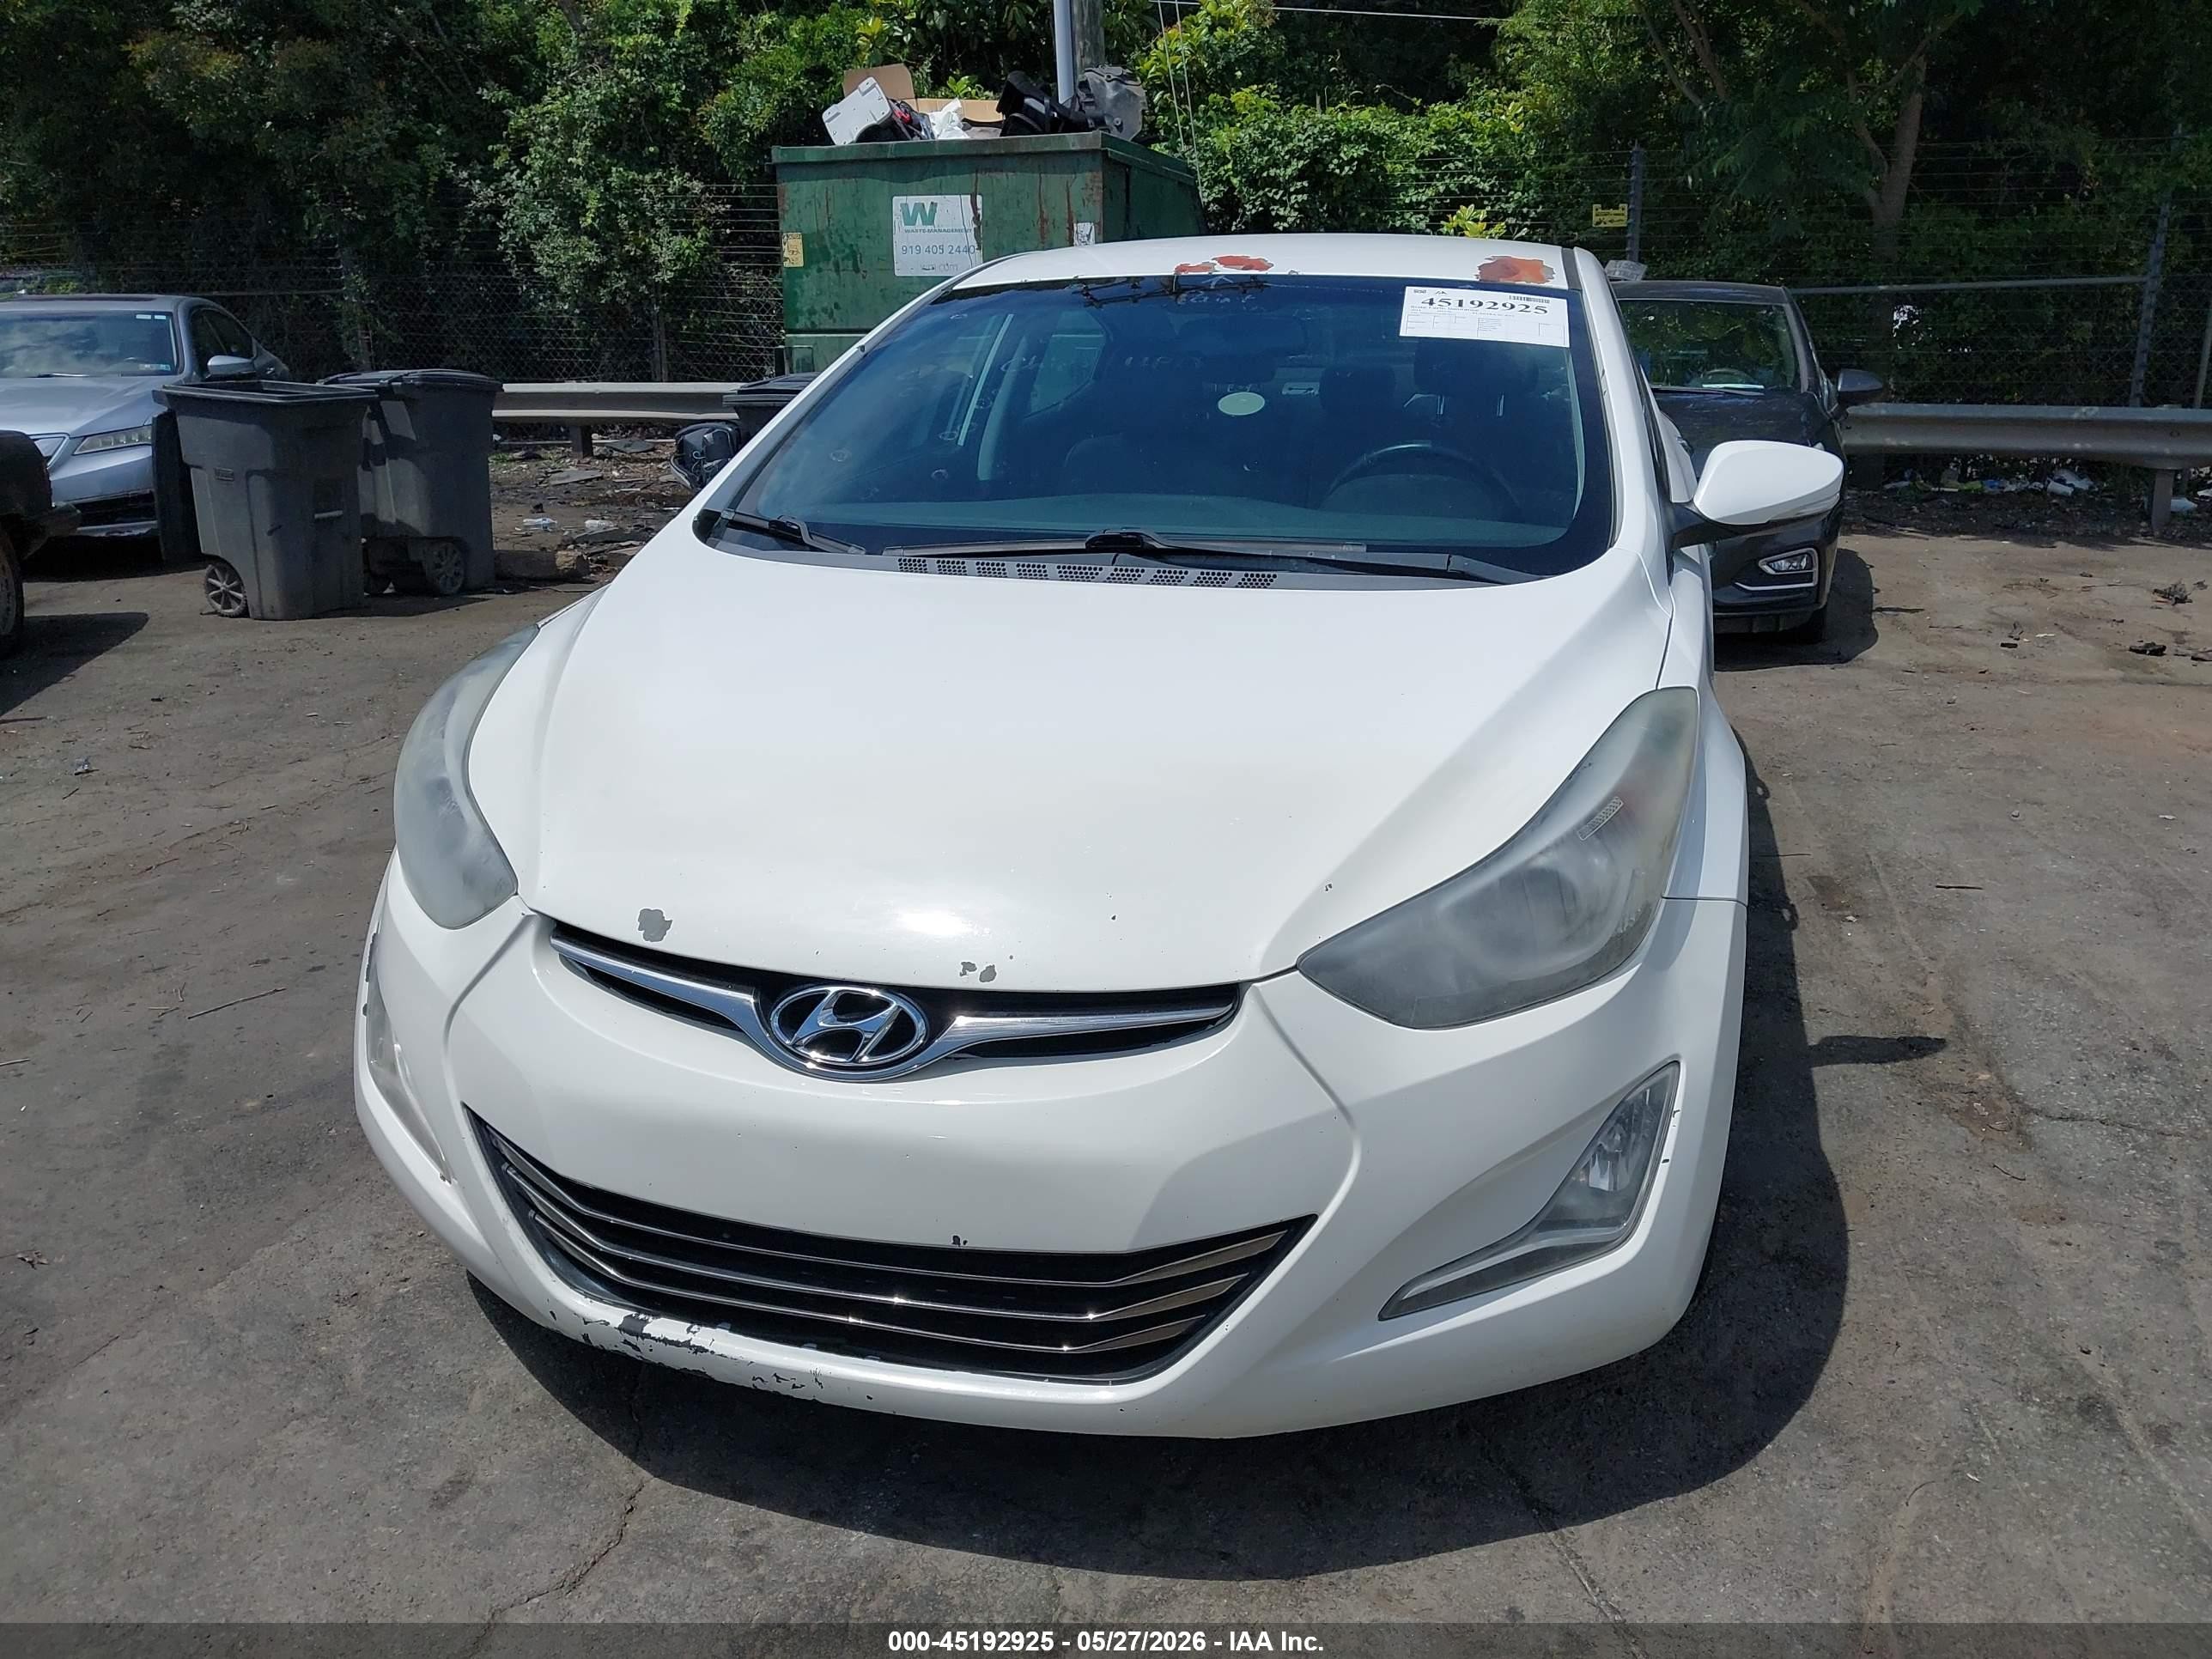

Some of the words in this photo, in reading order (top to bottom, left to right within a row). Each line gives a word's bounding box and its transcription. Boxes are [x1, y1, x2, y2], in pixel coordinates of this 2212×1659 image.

[901, 245, 921, 255] 919
[924, 245, 945, 255] 405
[947, 245, 975, 255] 2440
[1421, 297, 1548, 315] 45192925
